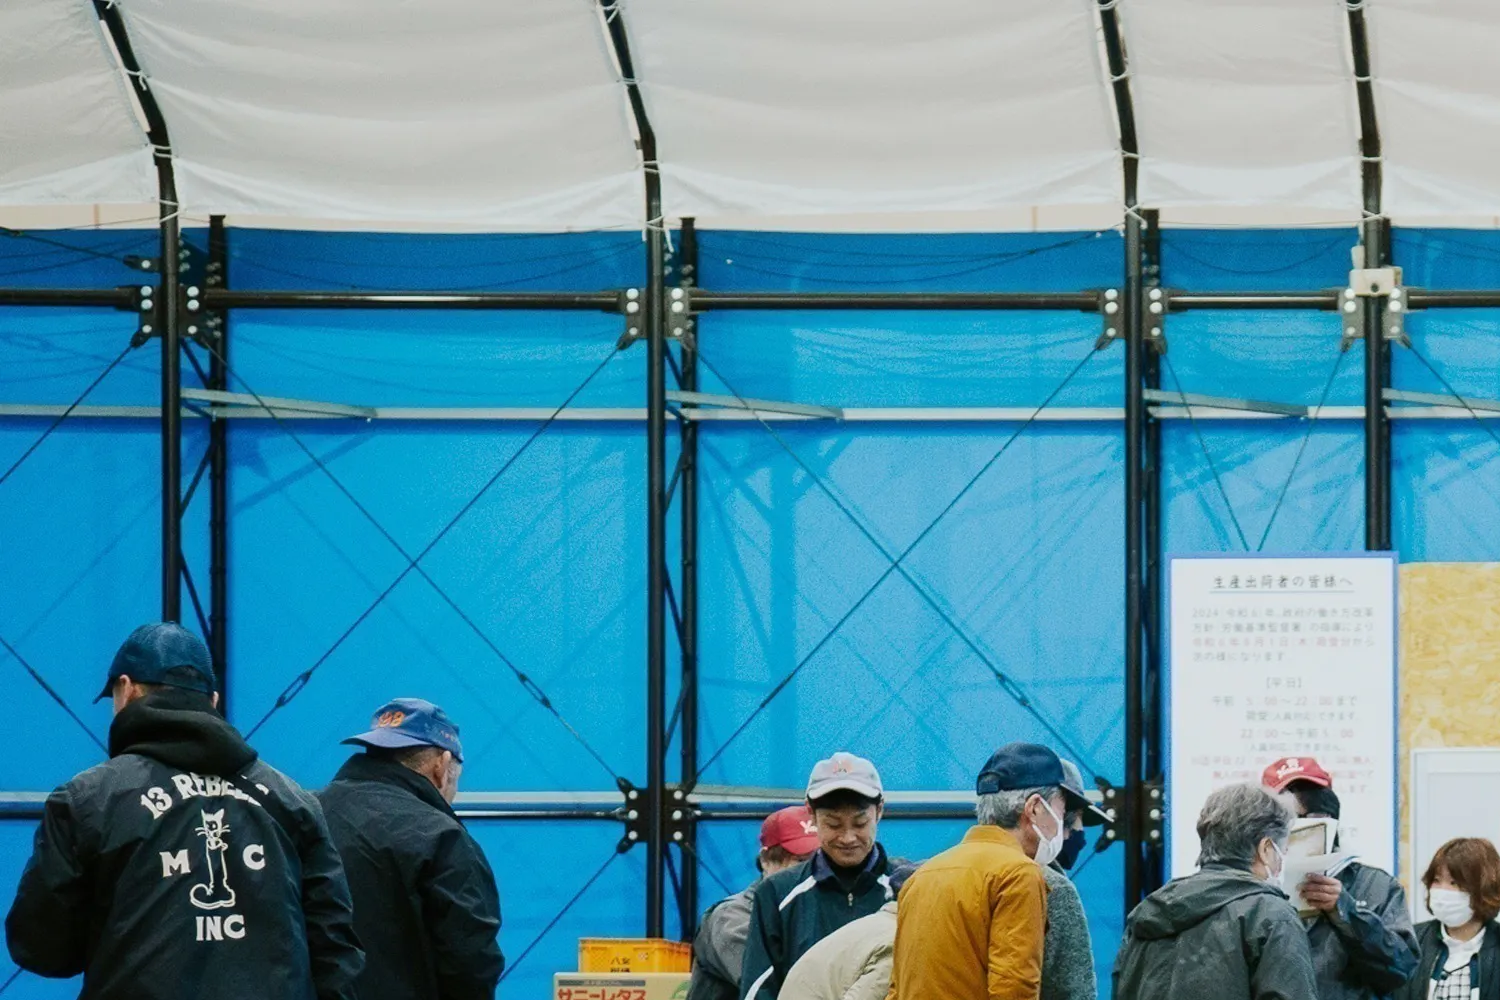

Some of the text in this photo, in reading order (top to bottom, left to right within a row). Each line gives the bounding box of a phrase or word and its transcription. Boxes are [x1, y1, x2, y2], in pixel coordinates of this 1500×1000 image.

[140, 787, 173, 820] 13
[159, 844, 266, 877] M C
[195, 914, 246, 941] INC
